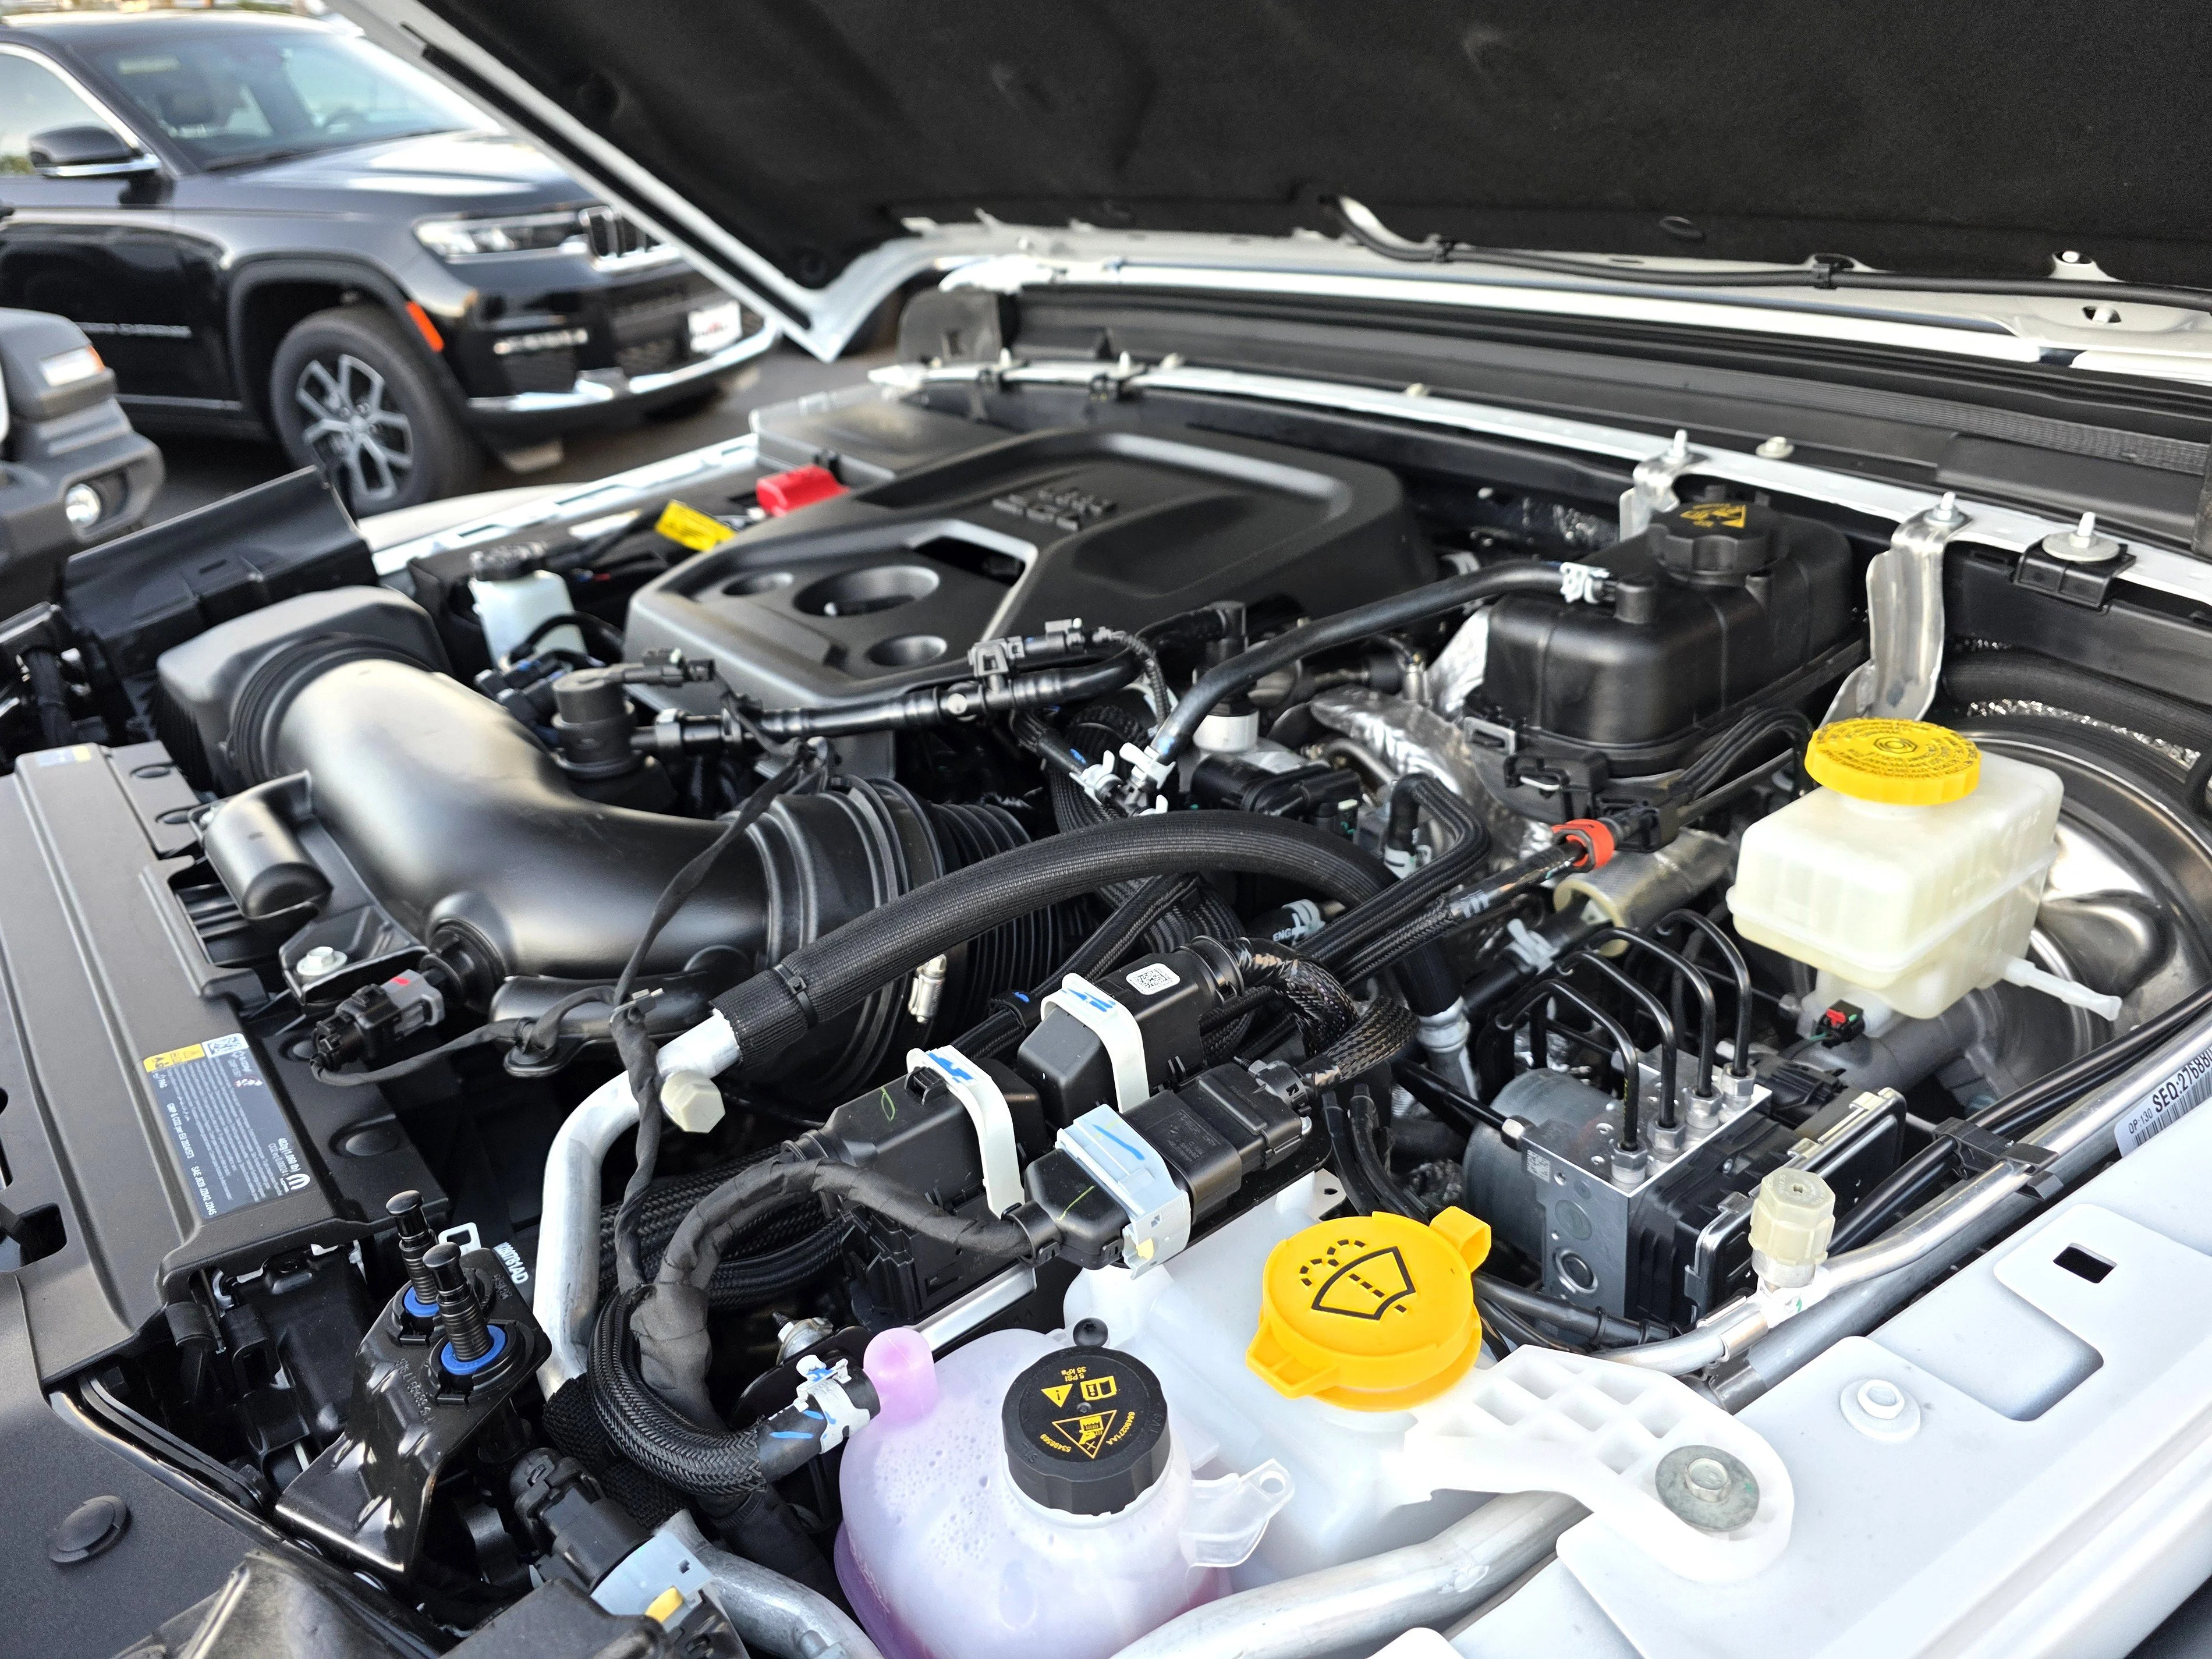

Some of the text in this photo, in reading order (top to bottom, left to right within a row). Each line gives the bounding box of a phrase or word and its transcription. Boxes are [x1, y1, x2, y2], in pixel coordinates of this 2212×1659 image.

[1272, 927, 1292, 941] ENG
[173, 1125, 183, 1134] per
[2128, 1108, 2153, 1134] OP:130
[190, 1165, 217, 1215] SAE J639 J2842 J2845
